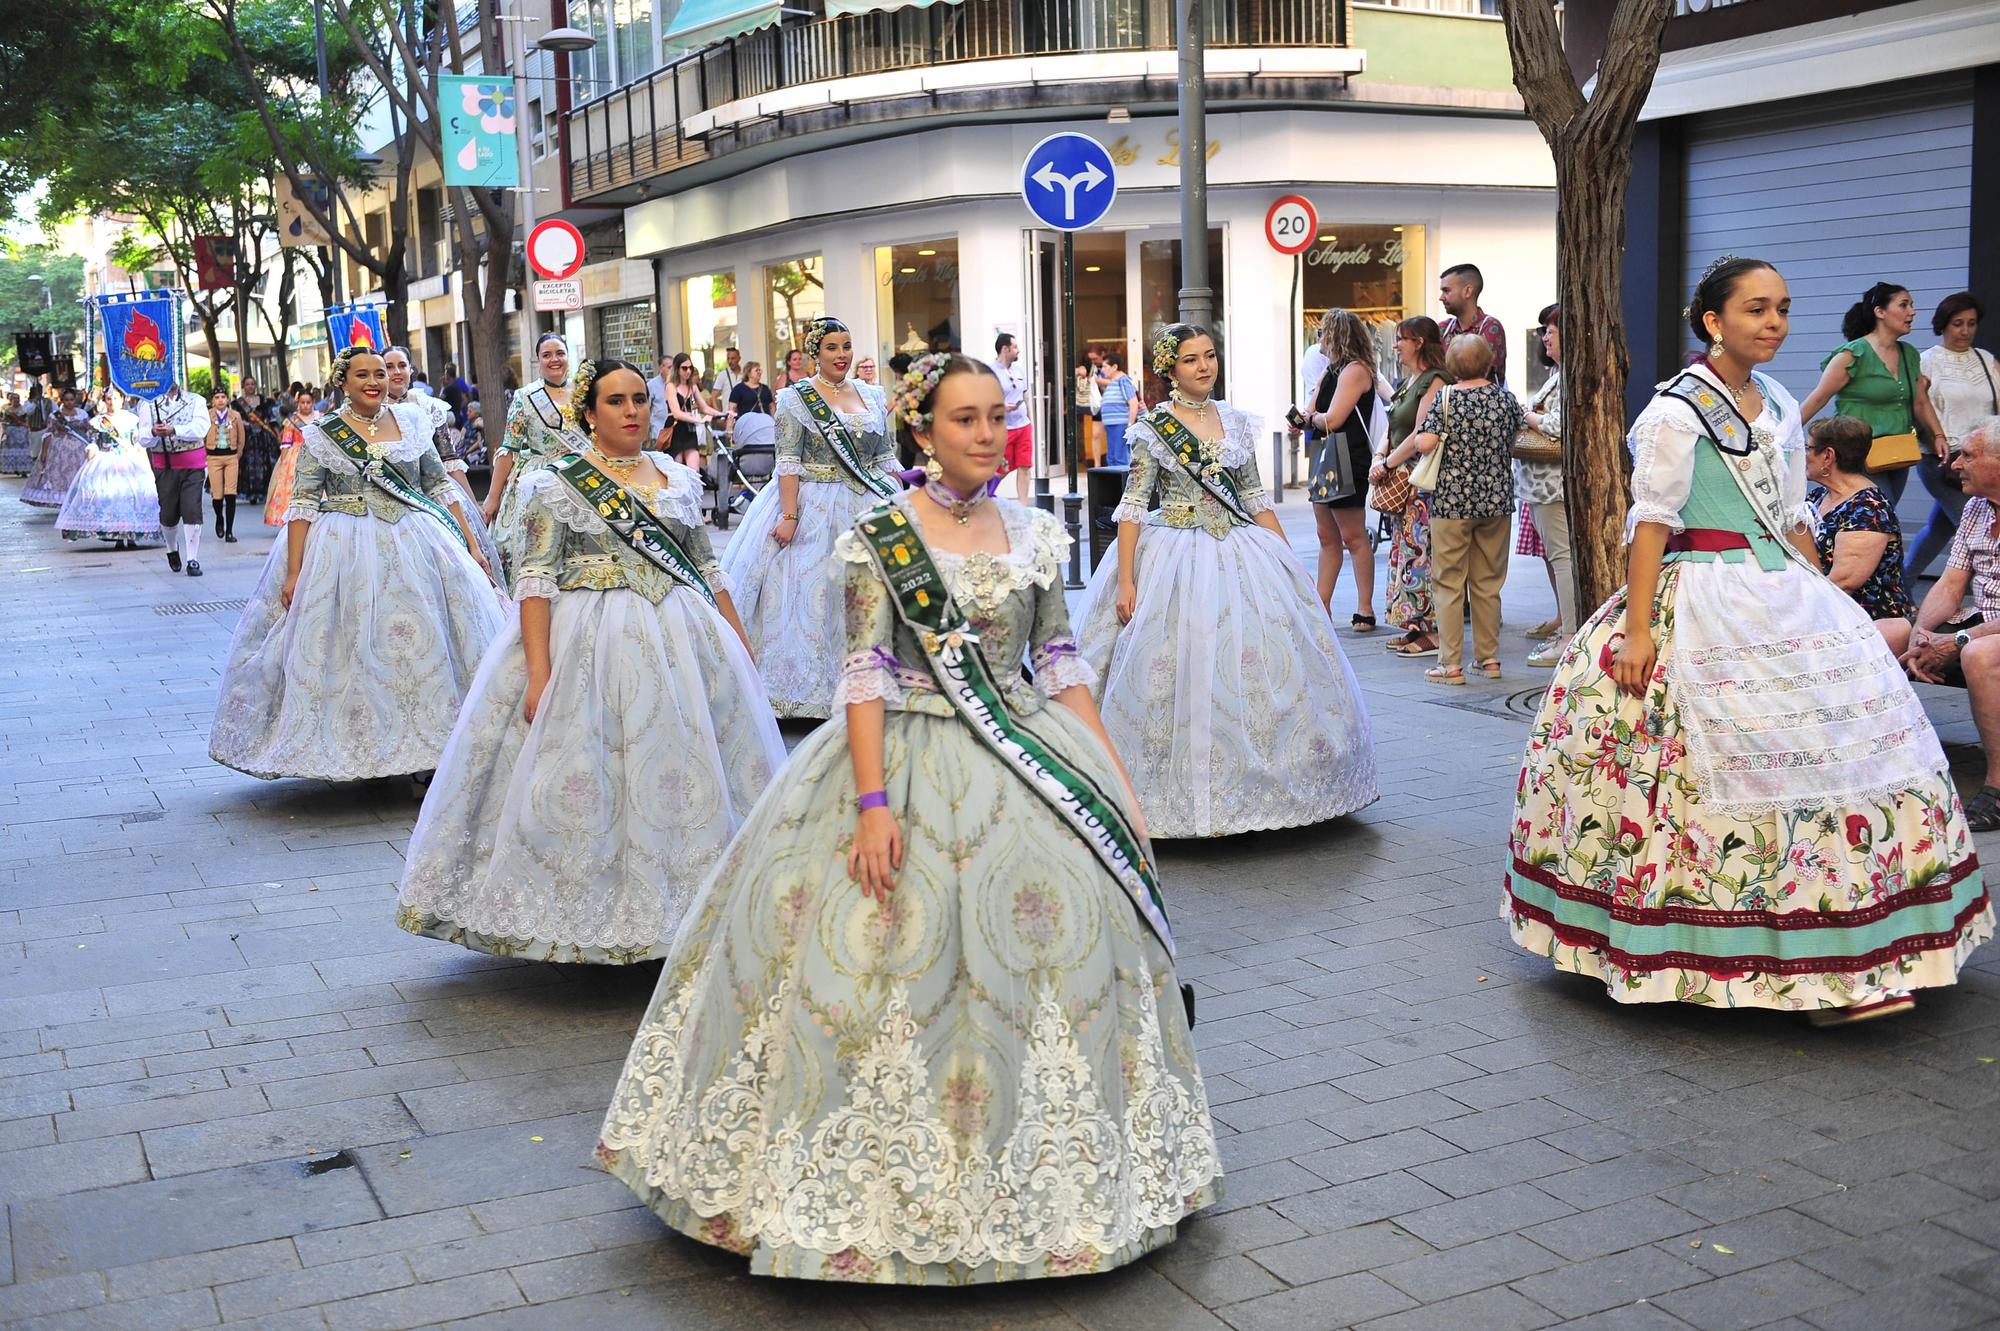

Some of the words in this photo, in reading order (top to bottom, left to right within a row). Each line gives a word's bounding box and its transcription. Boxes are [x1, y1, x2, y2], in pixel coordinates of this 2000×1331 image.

[1277, 216, 1305, 235] 20
[900, 572, 933, 593] 2022
[942, 652, 1011, 745] Dama
[1018, 747, 1056, 781] de
[1060, 786, 1134, 870] Honor
